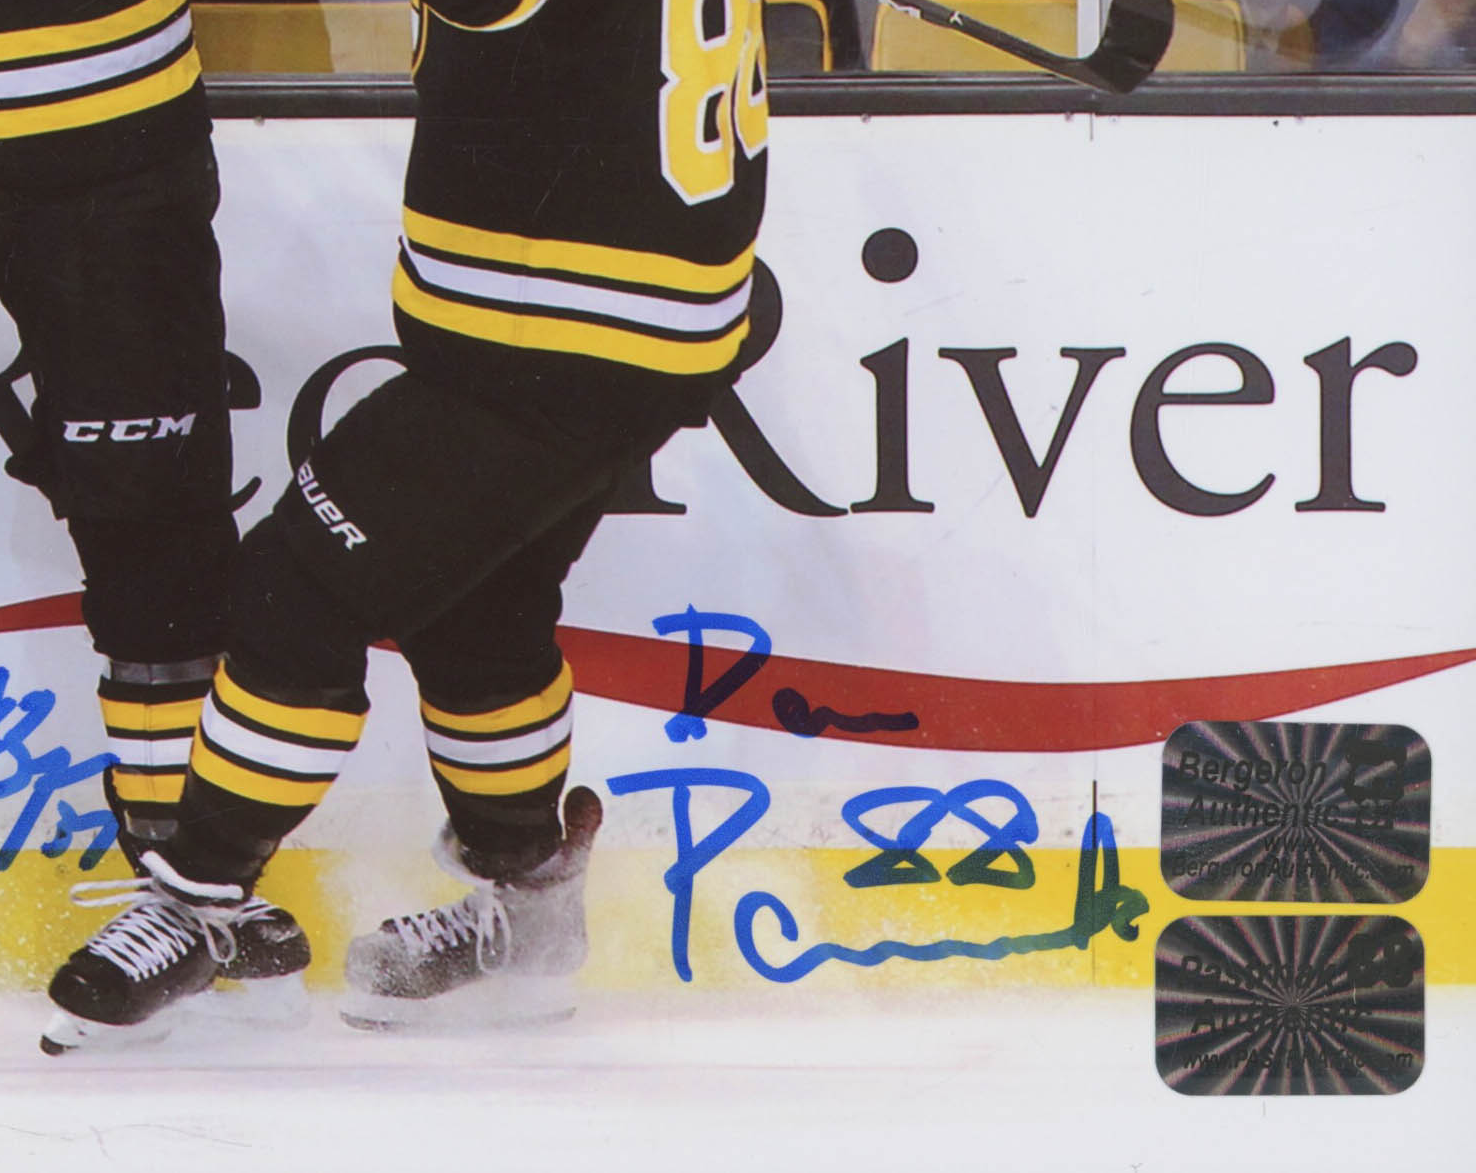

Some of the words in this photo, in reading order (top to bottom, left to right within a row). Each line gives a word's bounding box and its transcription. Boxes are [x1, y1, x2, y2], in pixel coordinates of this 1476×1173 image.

[63, 413, 196, 442] CCM
[1179, 750, 1328, 792] Bergeron
[1181, 794, 1342, 828] Authentic
[841, 777, 1039, 890] 88
